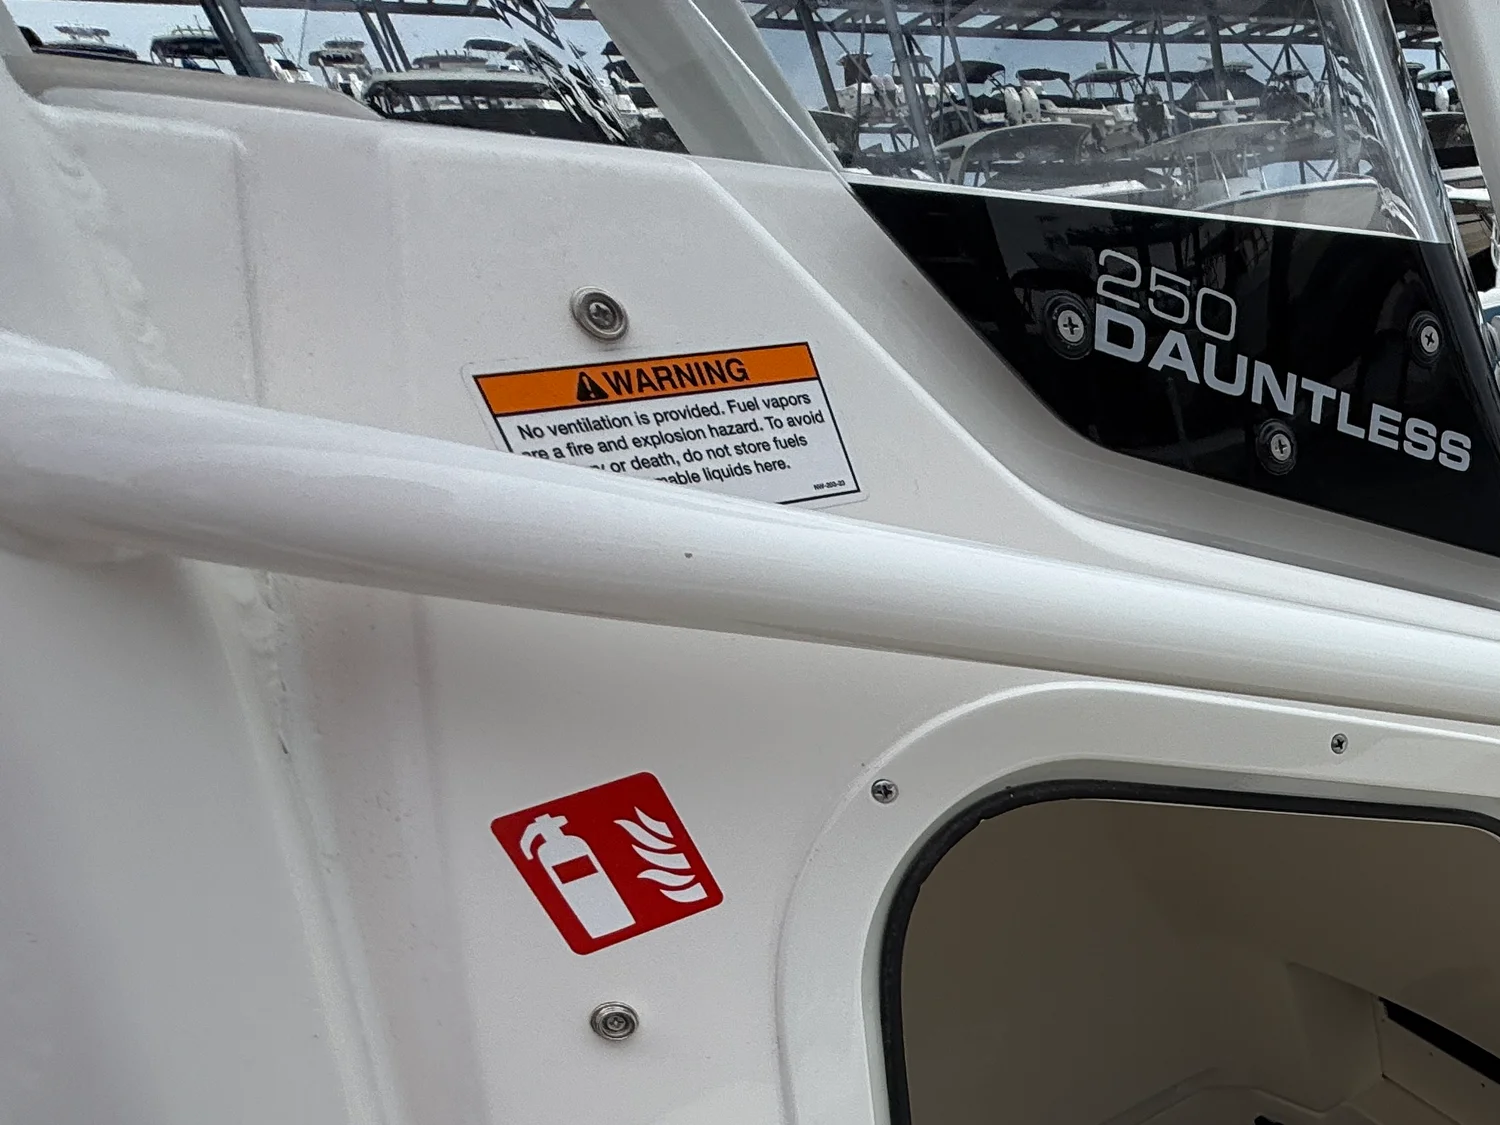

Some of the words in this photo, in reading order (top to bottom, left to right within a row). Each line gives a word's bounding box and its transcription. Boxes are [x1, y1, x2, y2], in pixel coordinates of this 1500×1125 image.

[1097, 248, 1237, 342] 250
[602, 358, 750, 396] WARNING
[1093, 303, 1473, 472] DAUNTLESS
[517, 424, 545, 440] No
[546, 415, 633, 437] ventilation
[634, 411, 650, 425] is
[653, 402, 725, 426] provided.
[727, 397, 760, 414] Fuel
[762, 393, 812, 411] vapors
[552, 447, 566, 459] a
[566, 442, 594, 457] fire
[597, 435, 629, 453] and
[632, 427, 706, 449] explosion
[708, 420, 764, 438] hazard.
[764, 416, 783, 430] To
[786, 409, 825, 428] avoid
[610, 461, 626, 473] or
[631, 452, 681, 471] death,
[682, 449, 703, 463] do
[706, 445, 731, 461] not
[733, 439, 771, 455] store
[772, 434, 808, 450] fuels
[702, 463, 753, 482] liquids
[754, 459, 791, 475] here.
